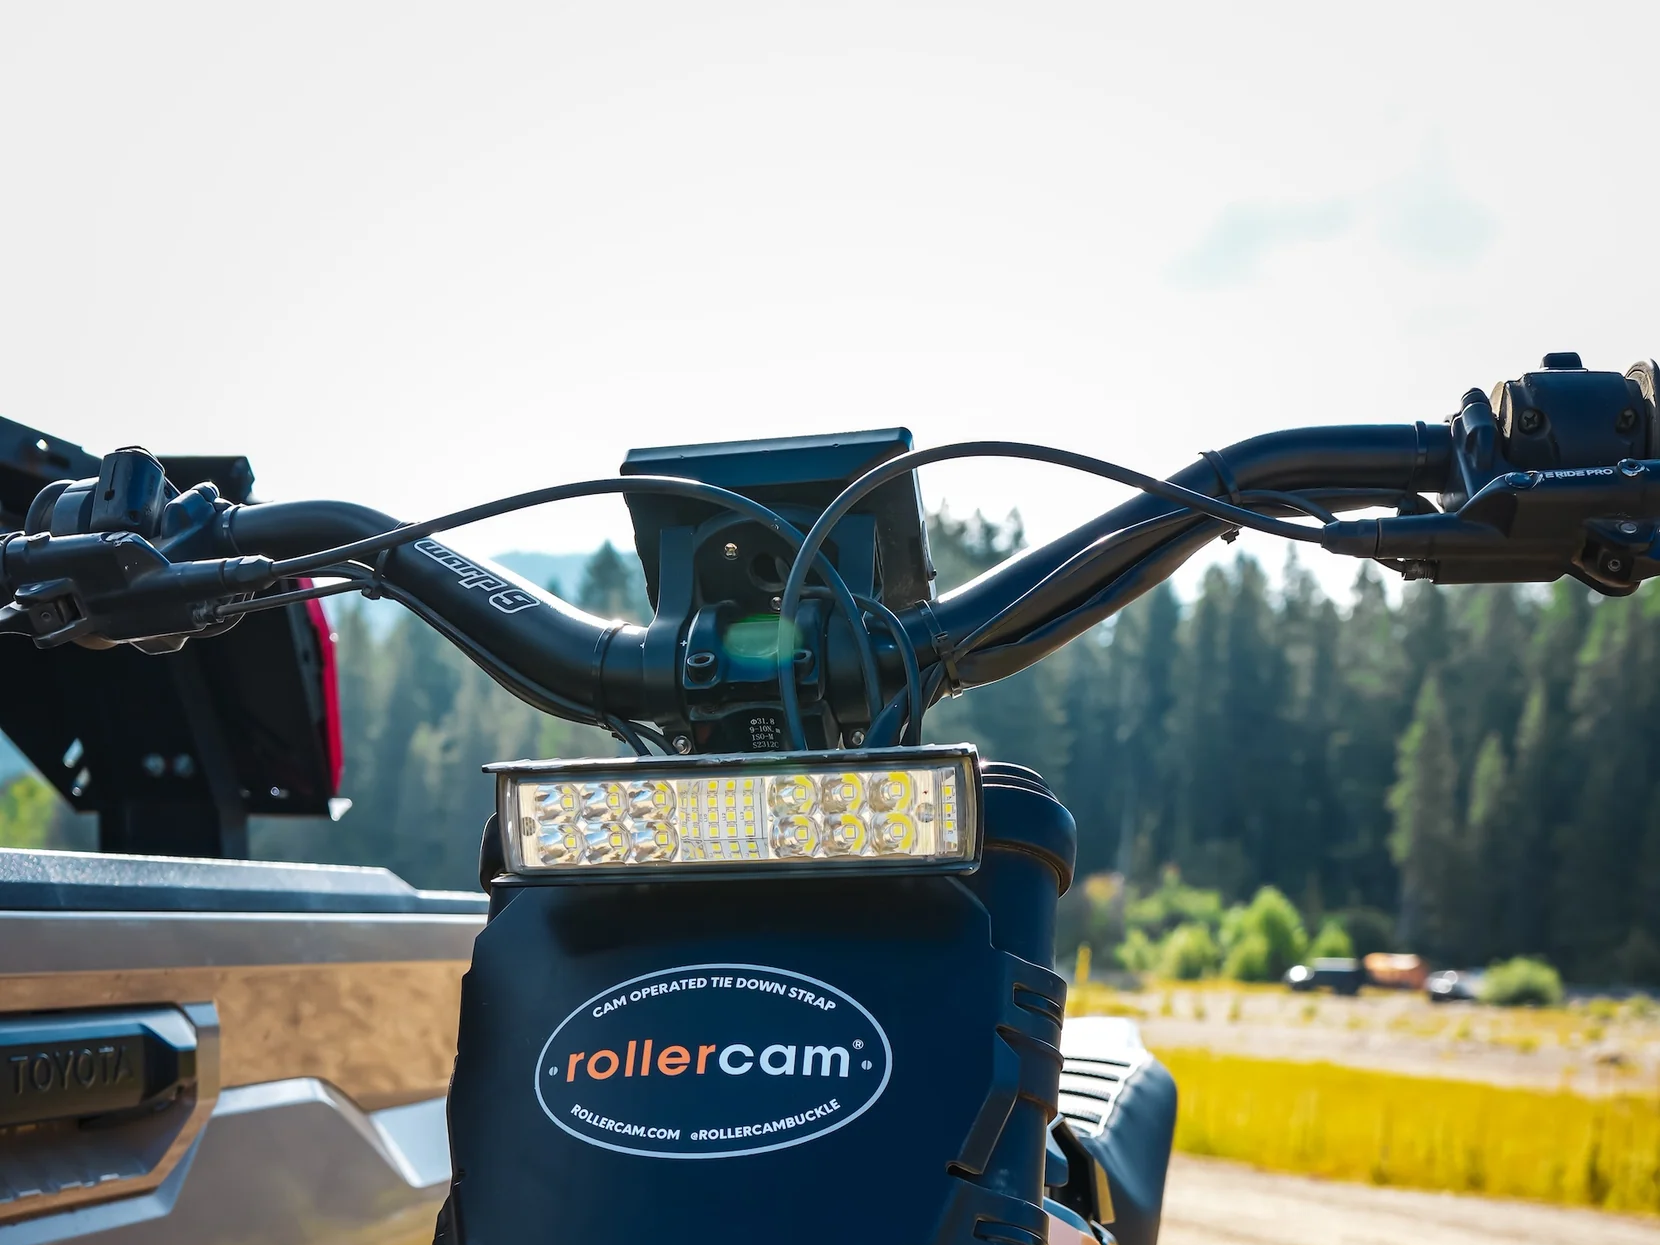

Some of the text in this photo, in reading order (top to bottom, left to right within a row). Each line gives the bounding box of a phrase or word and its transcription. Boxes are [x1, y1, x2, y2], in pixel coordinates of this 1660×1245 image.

[592, 976, 837, 1018] CAM OPERATED TIE DOWN STRAP
[9, 1046, 134, 1095] TOYOTA
[570, 1098, 841, 1141] ROLLERCAM.COM @ROLLERCAMBUCKLE
